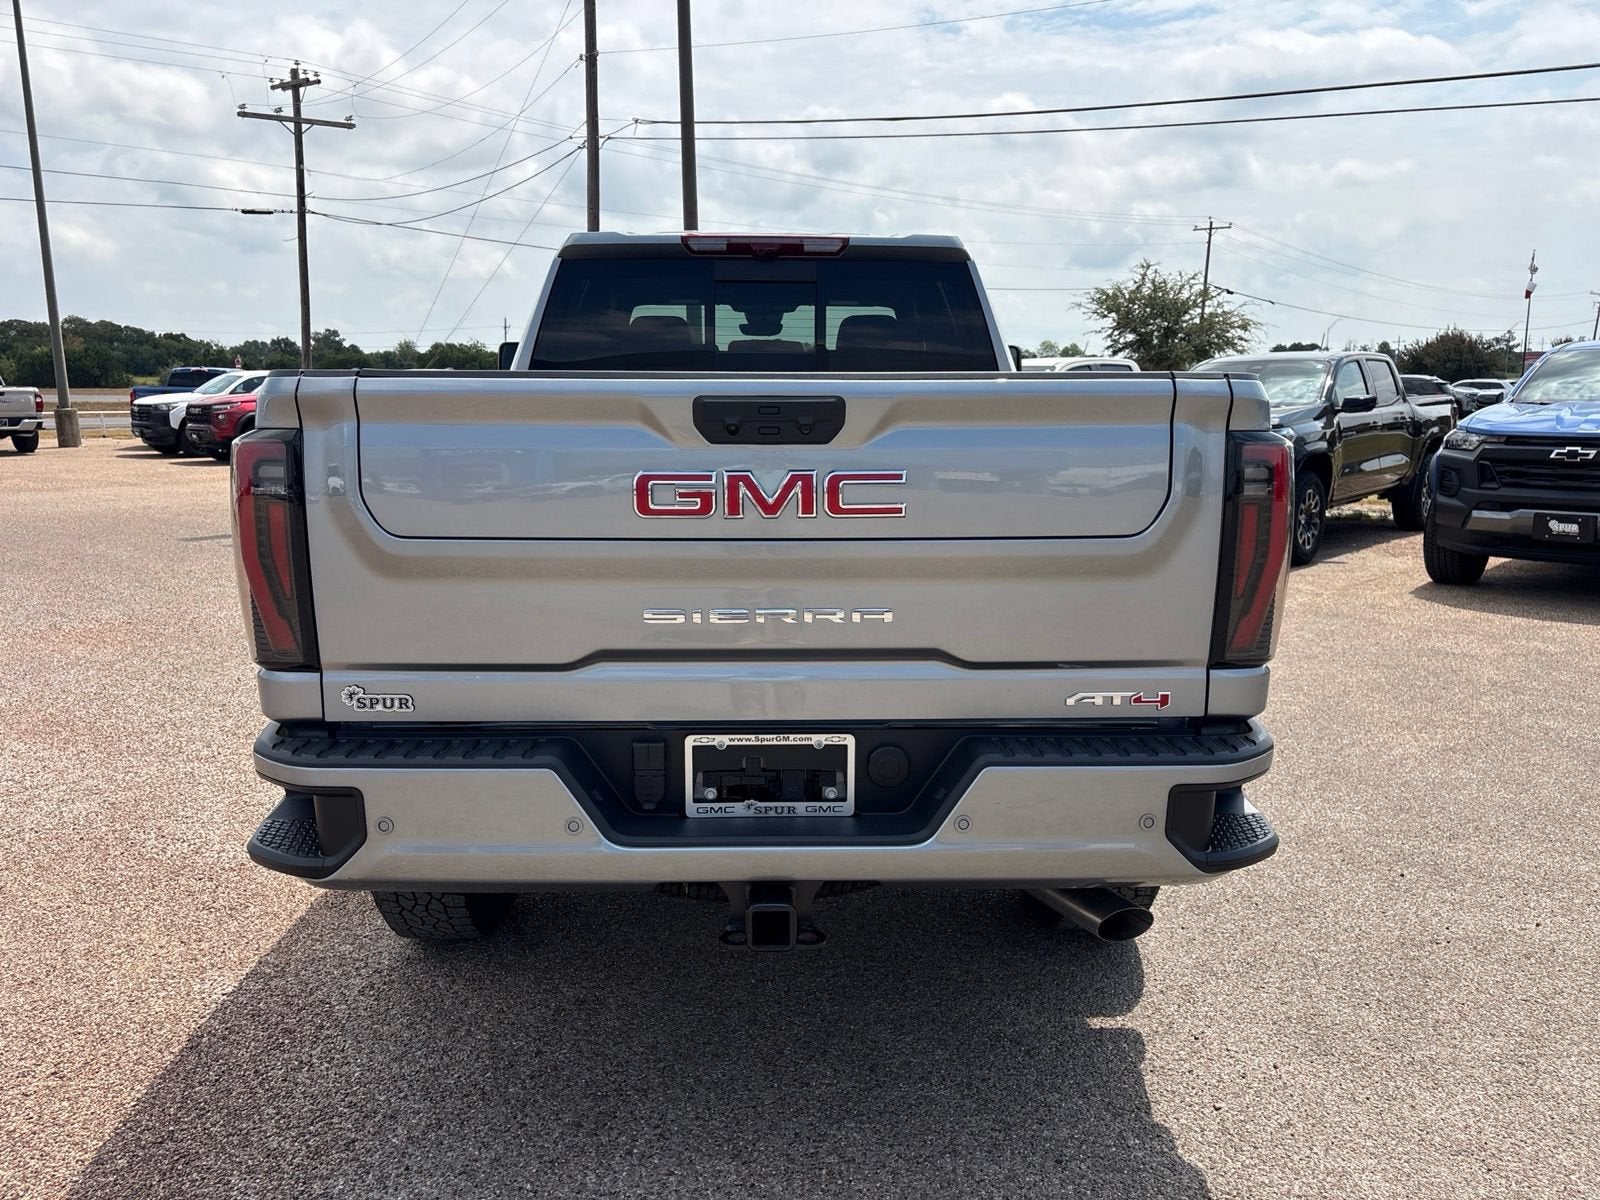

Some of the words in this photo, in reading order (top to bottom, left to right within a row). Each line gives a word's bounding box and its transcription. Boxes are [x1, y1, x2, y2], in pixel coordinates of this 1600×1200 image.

[633, 470, 907, 518] GMC
[642, 608, 893, 623] SIERRA
[356, 697, 411, 709] SPUR
[1065, 692, 1171, 710] AT4
[728, 735, 813, 744] www.SpurGM.com
[696, 806, 736, 814] GMC
[753, 806, 797, 815] SPUR
[805, 805, 844, 813] GMC
